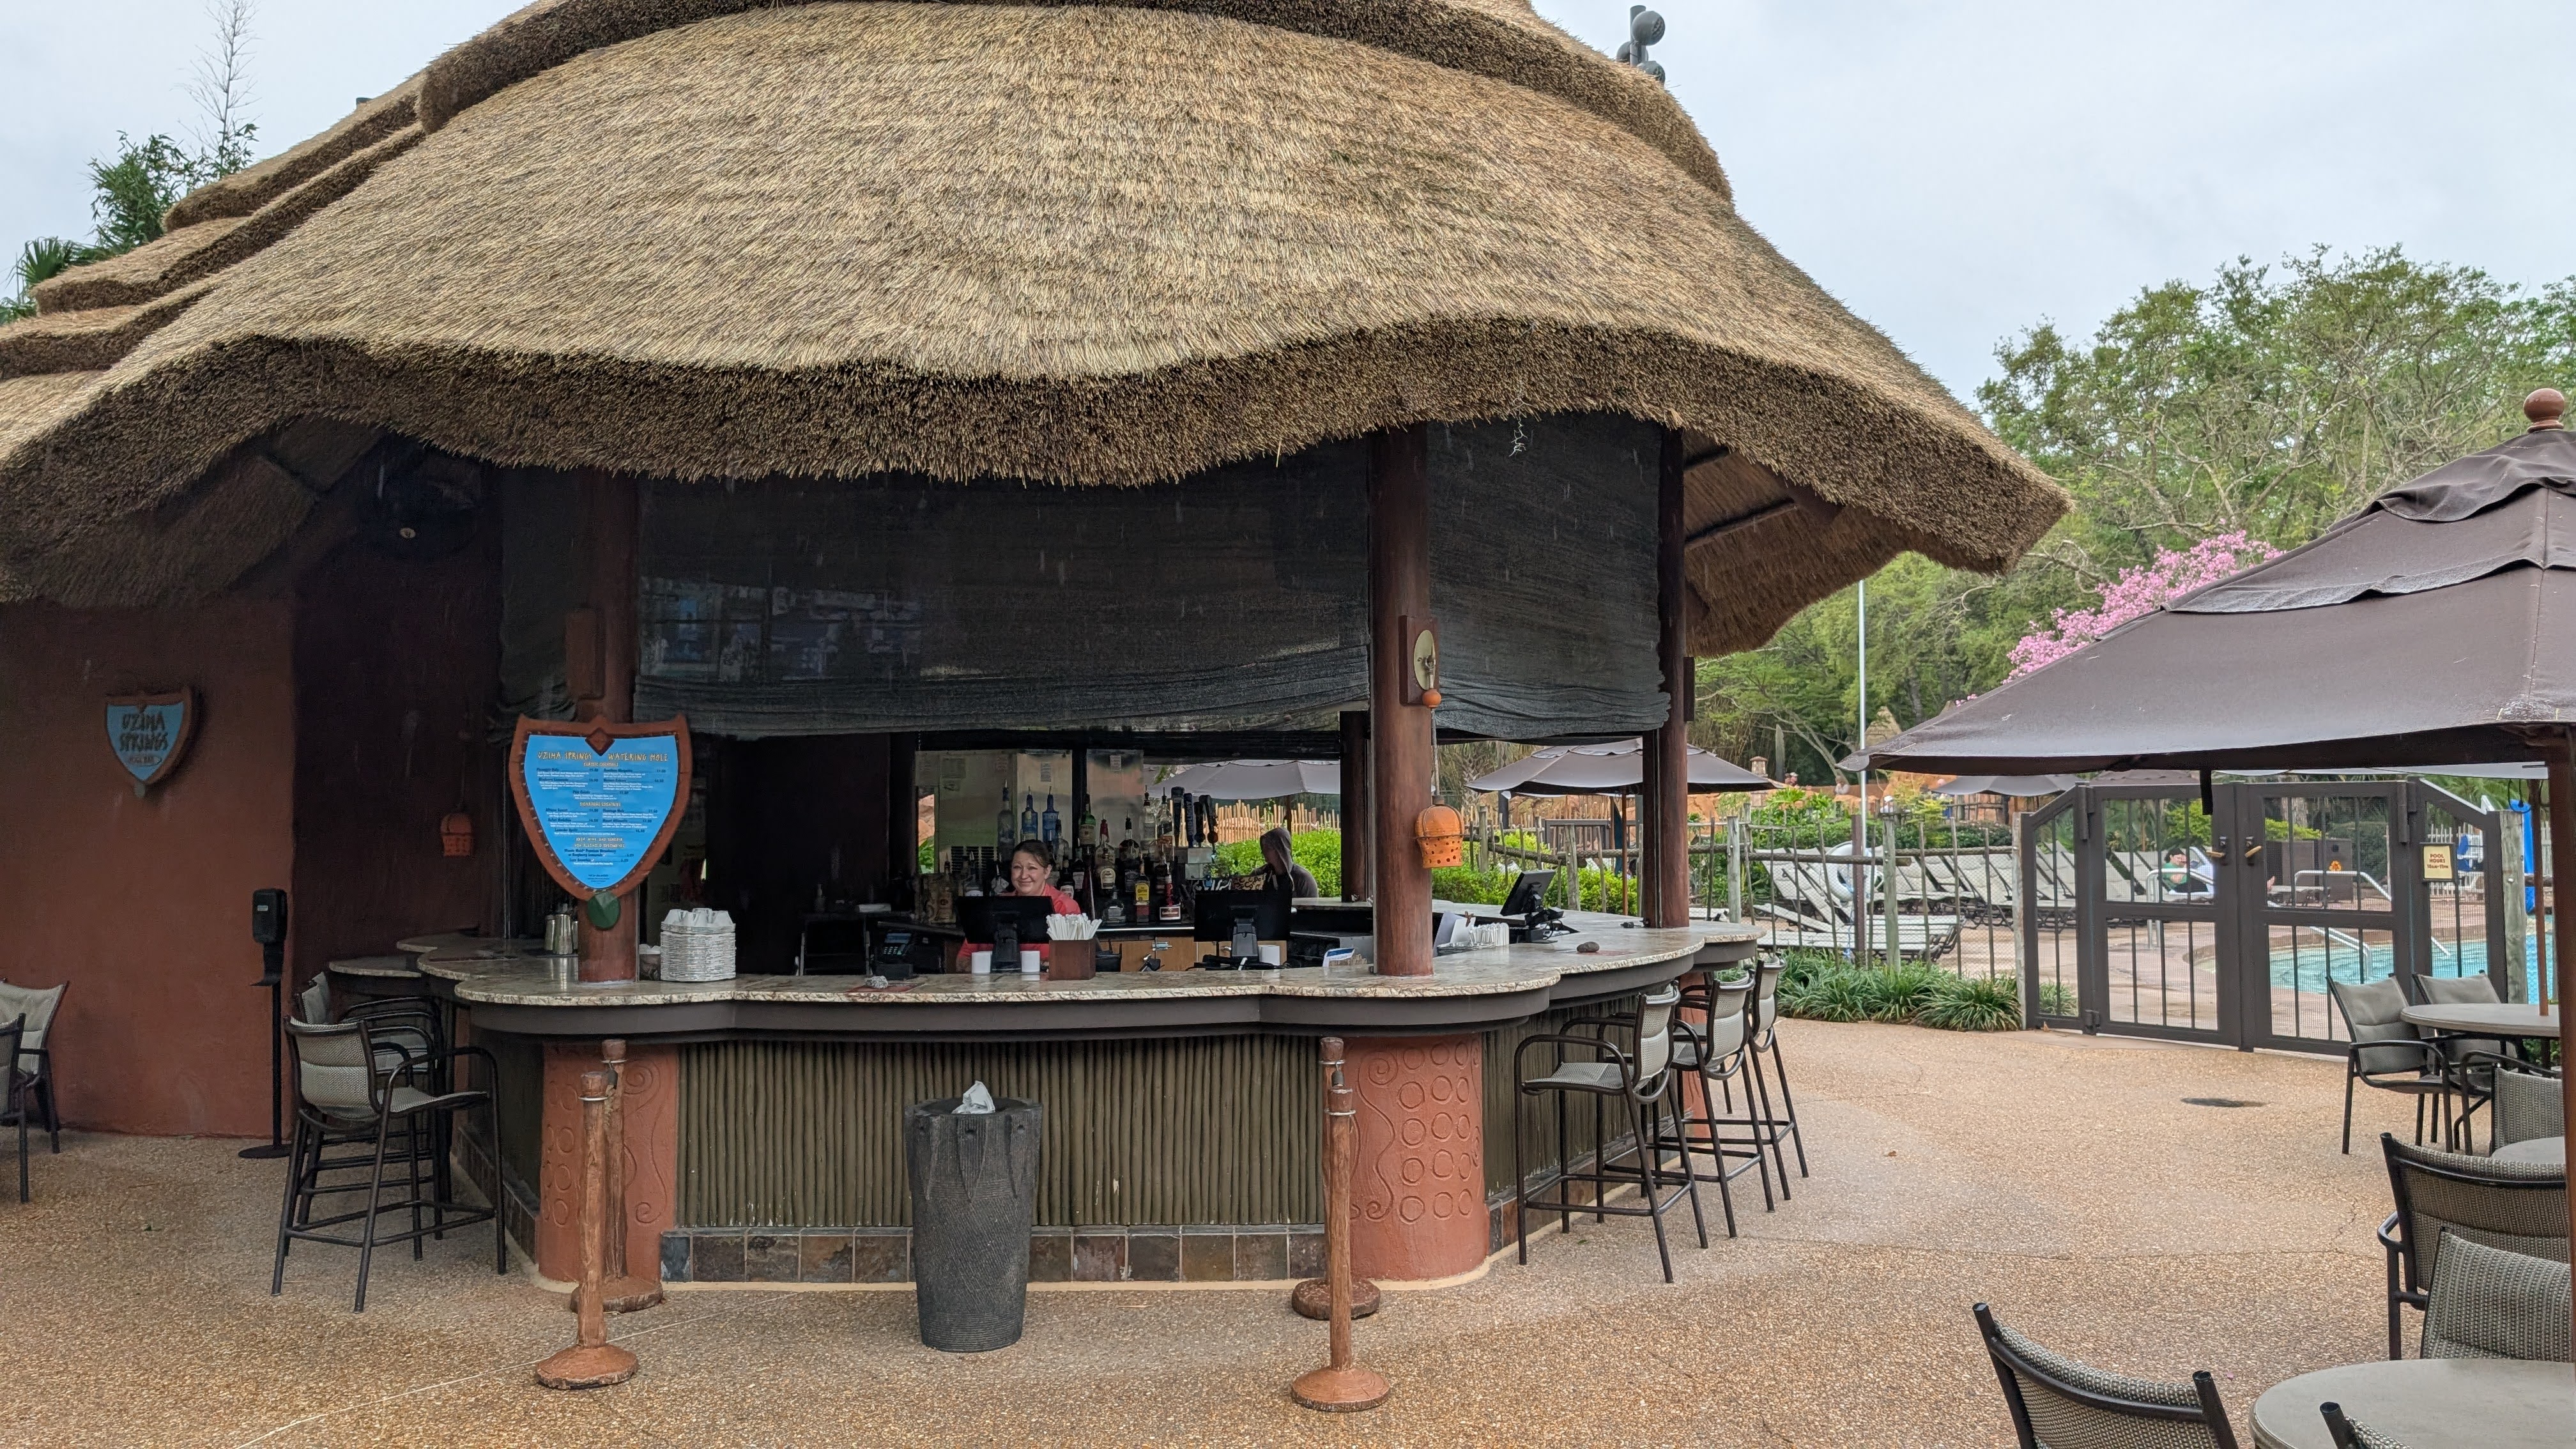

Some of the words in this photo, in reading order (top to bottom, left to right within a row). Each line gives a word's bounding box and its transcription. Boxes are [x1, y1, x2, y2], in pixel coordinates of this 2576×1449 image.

[121, 712, 165, 731] UZIMA
[537, 751, 561, 760] UZIMA
[565, 751, 592, 760] SPRINGS
[608, 752, 647, 762] WATERING
[650, 753, 668, 762] HOLE
